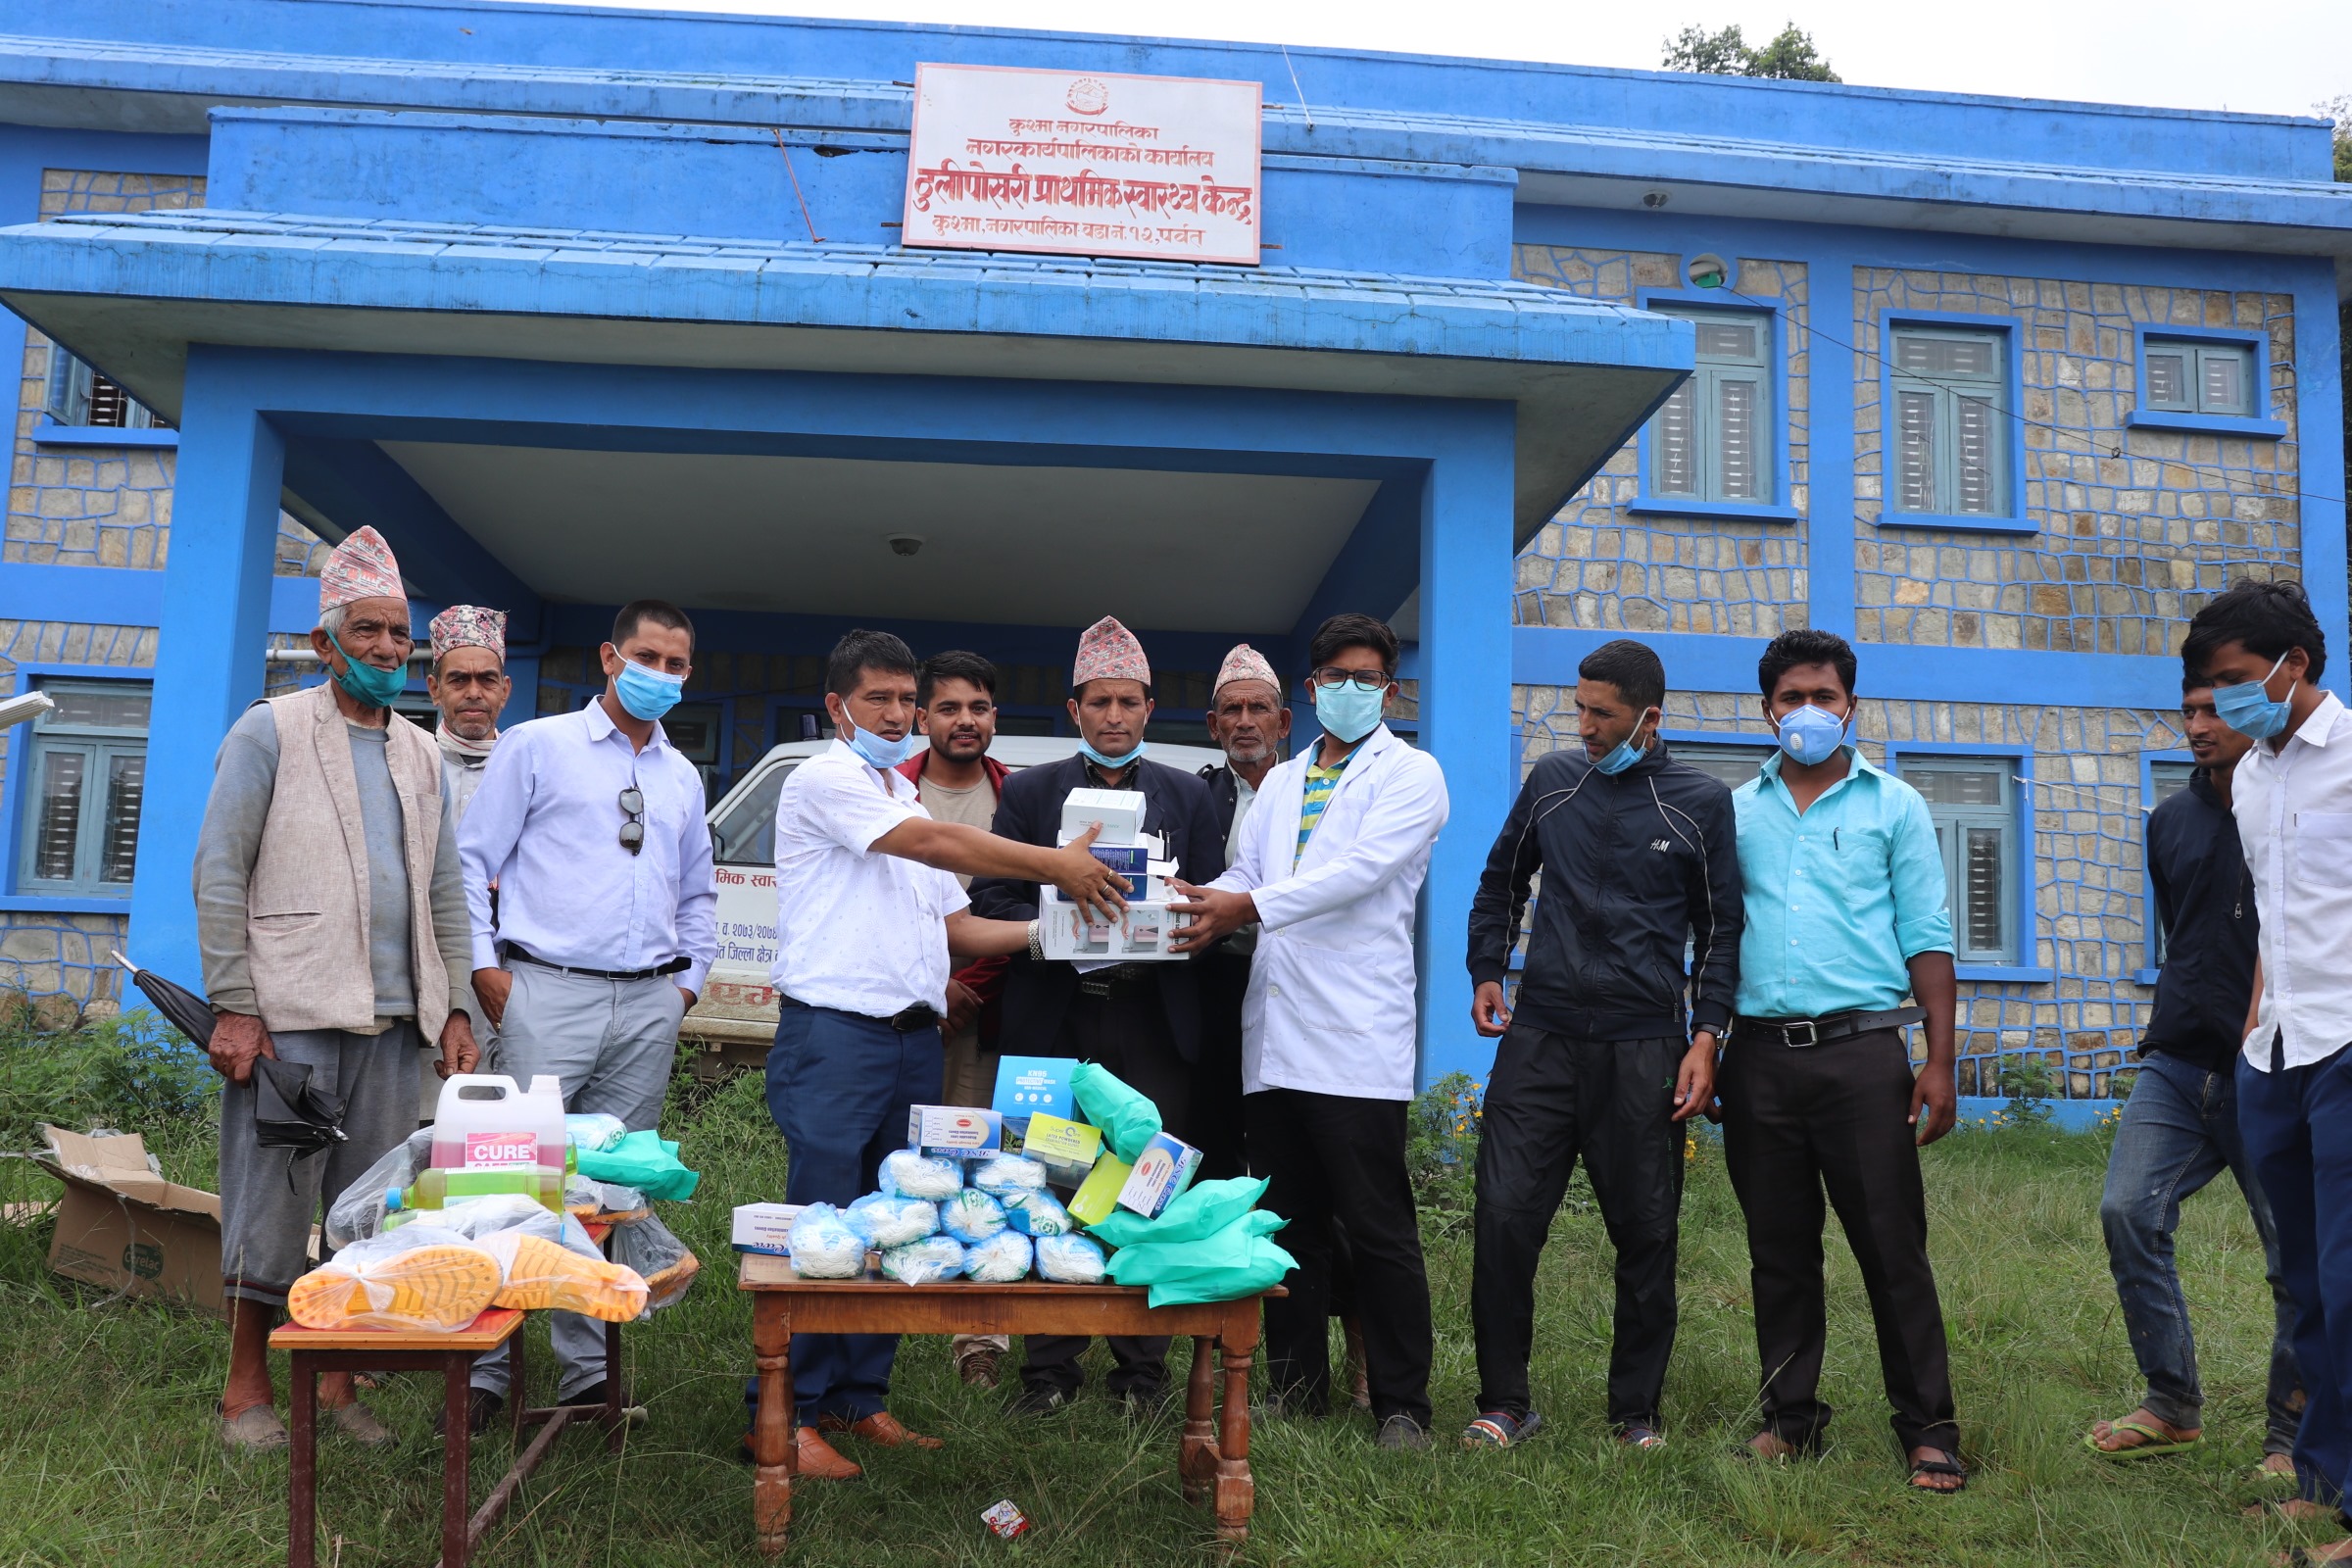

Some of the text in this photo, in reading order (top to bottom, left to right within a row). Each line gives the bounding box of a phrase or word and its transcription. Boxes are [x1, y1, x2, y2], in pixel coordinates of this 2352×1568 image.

[1056, 120, 1159, 140] नगरपालिका
[1144, 145, 1214, 168] कार्यालय
[1033, 169, 1122, 209] प्राथमिक
[1123, 179, 1200, 220] स्वास्थ्य
[1200, 174, 1252, 224] केन्द्र
[1650, 839, 1670, 852] H&M
[715, 868, 746, 884] मिक
[728, 942, 755, 961] जिल्ला
[473, 1144, 530, 1160] CURE
